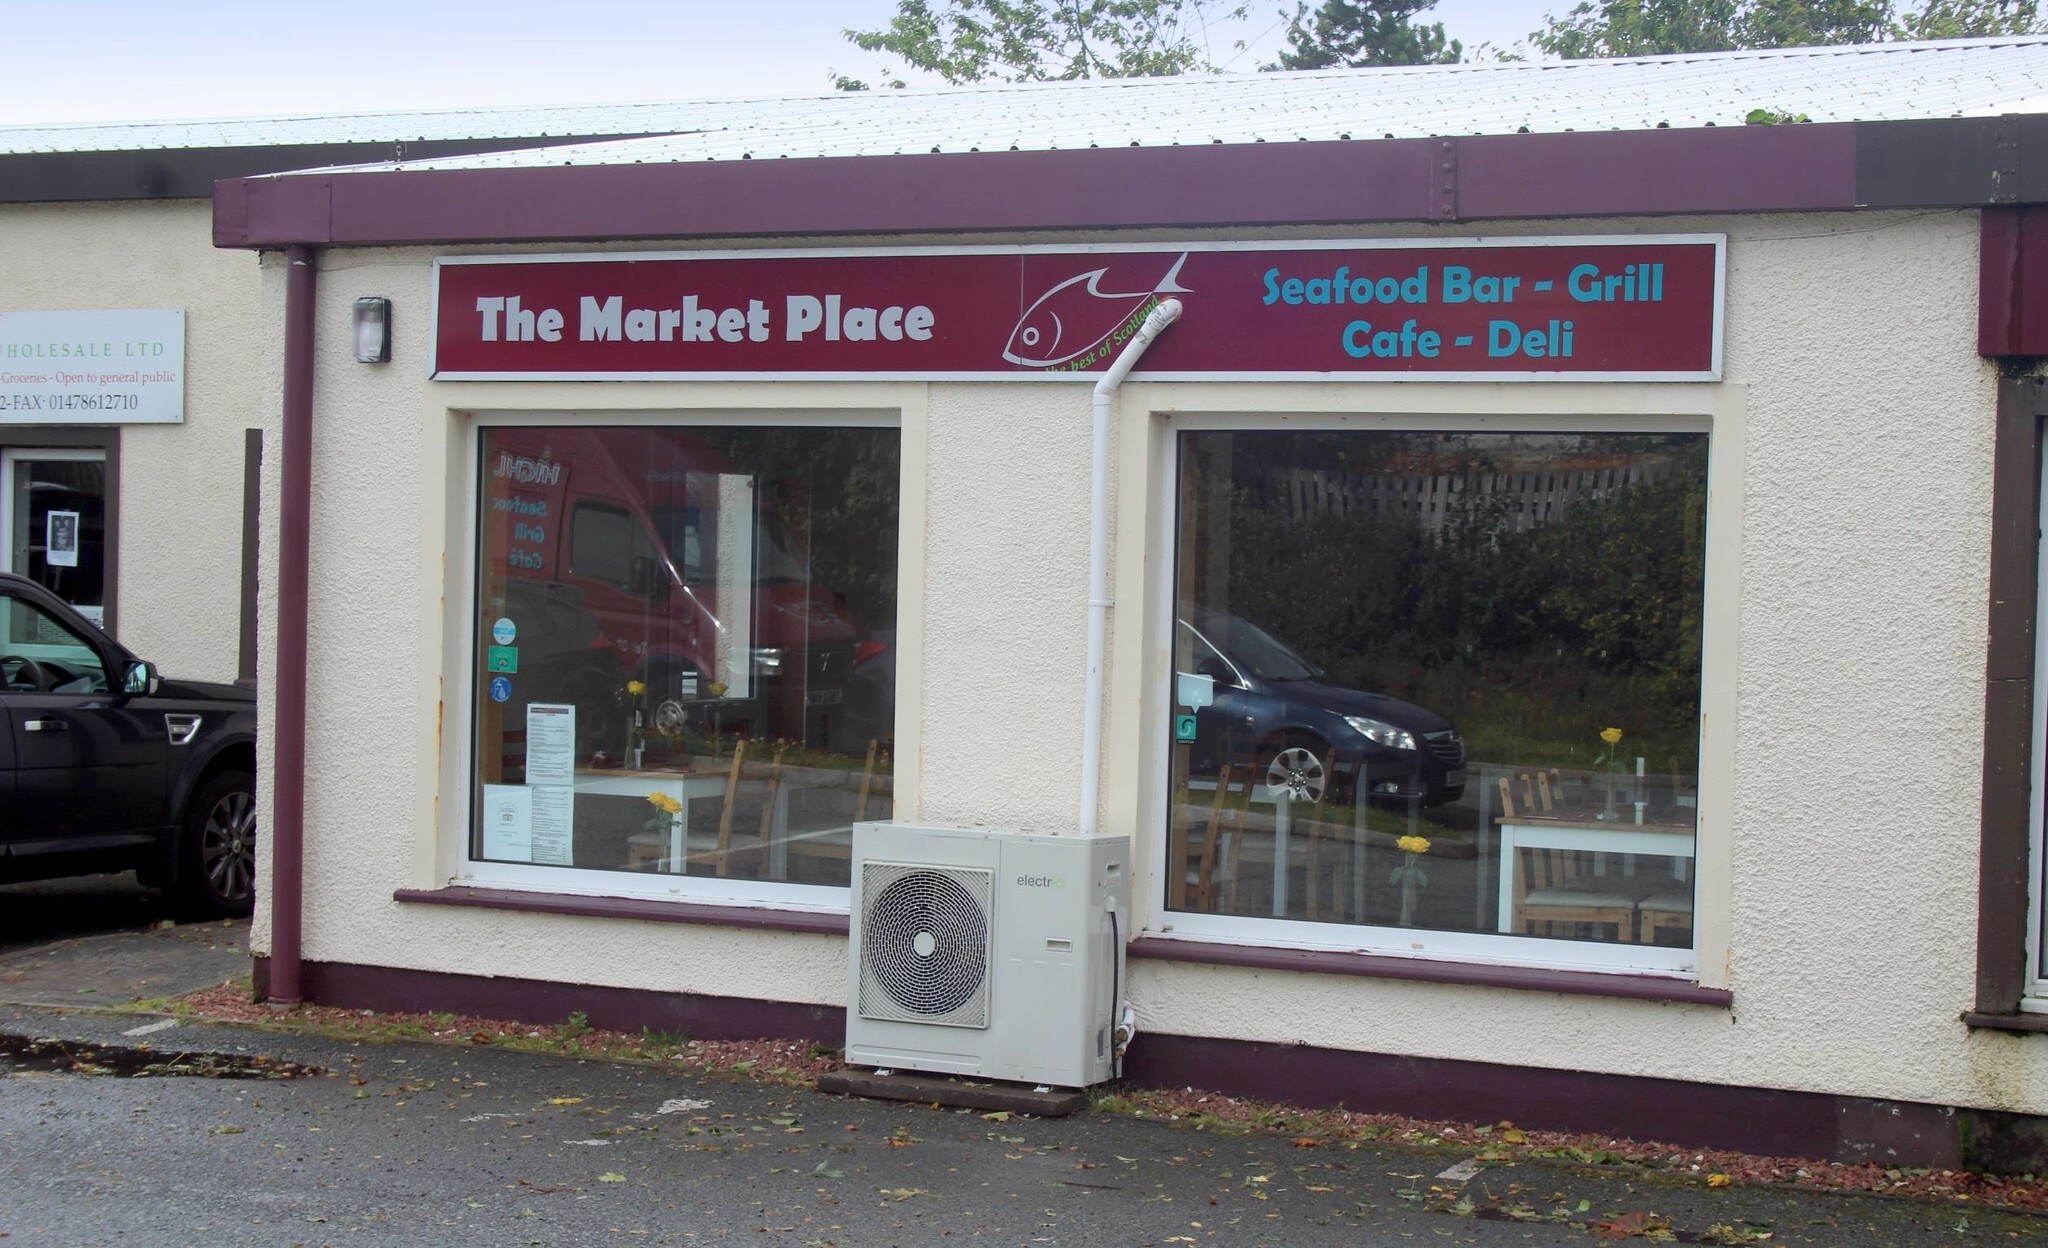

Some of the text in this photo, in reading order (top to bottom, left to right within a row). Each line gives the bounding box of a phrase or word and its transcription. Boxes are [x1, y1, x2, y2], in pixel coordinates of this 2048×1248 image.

[1263, 263, 1665, 306] Seafood Bar - Grill
[476, 294, 935, 342] The Market Place
[1070, 352, 1097, 372] best
[1099, 338, 1112, 356] of
[1113, 294, 1160, 346] Scotland
[1342, 318, 1575, 359] Cafe - Deli
[0, 342, 164, 358] HOLESALE LTD
[1, 371, 47, 384] Groceries
[55, 371, 84, 386] Open
[87, 373, 97, 383] to
[100, 371, 139, 386] general
[142, 371, 176, 386] public
[49, 394, 138, 410] 01478612710
